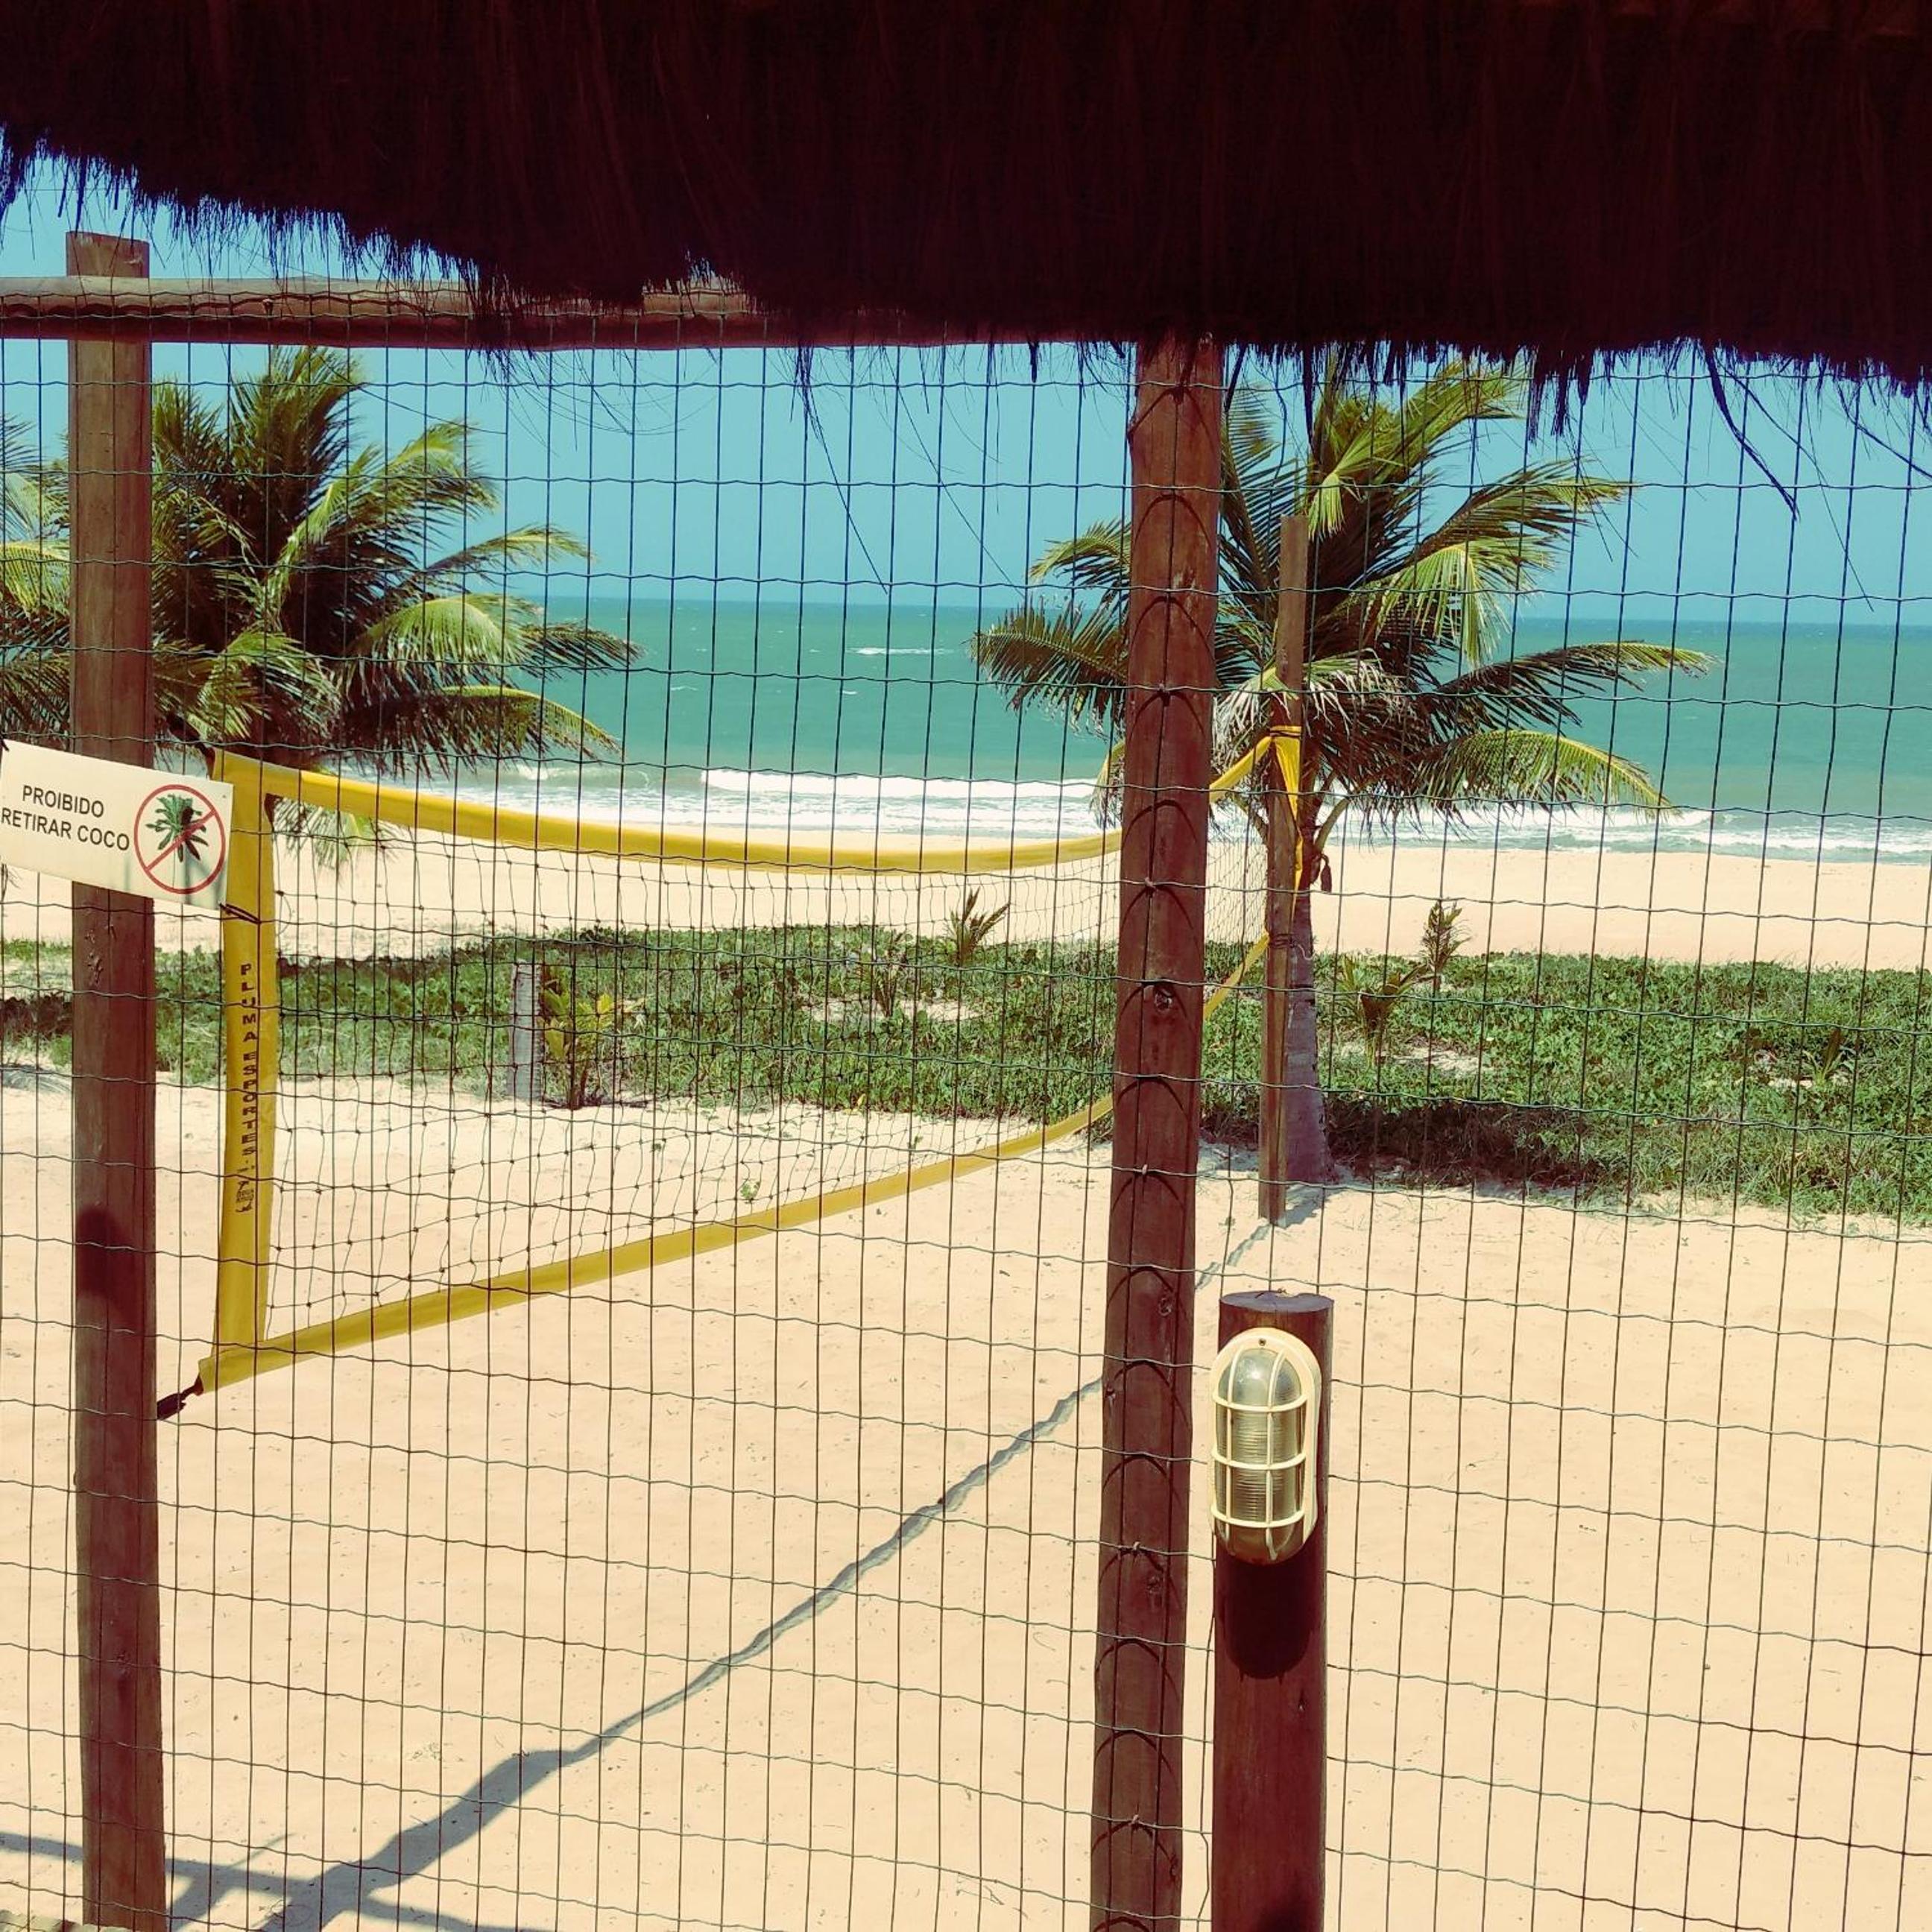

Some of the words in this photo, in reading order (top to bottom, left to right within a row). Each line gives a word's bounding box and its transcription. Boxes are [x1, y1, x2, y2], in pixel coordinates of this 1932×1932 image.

[1, 807, 72, 839] RETIRAR
[78, 824, 130, 851] COCO
[22, 785, 104, 818] PROIBIDO
[240, 963, 257, 1042] PLUMA
[241, 1051, 258, 1156] ESPORTES
